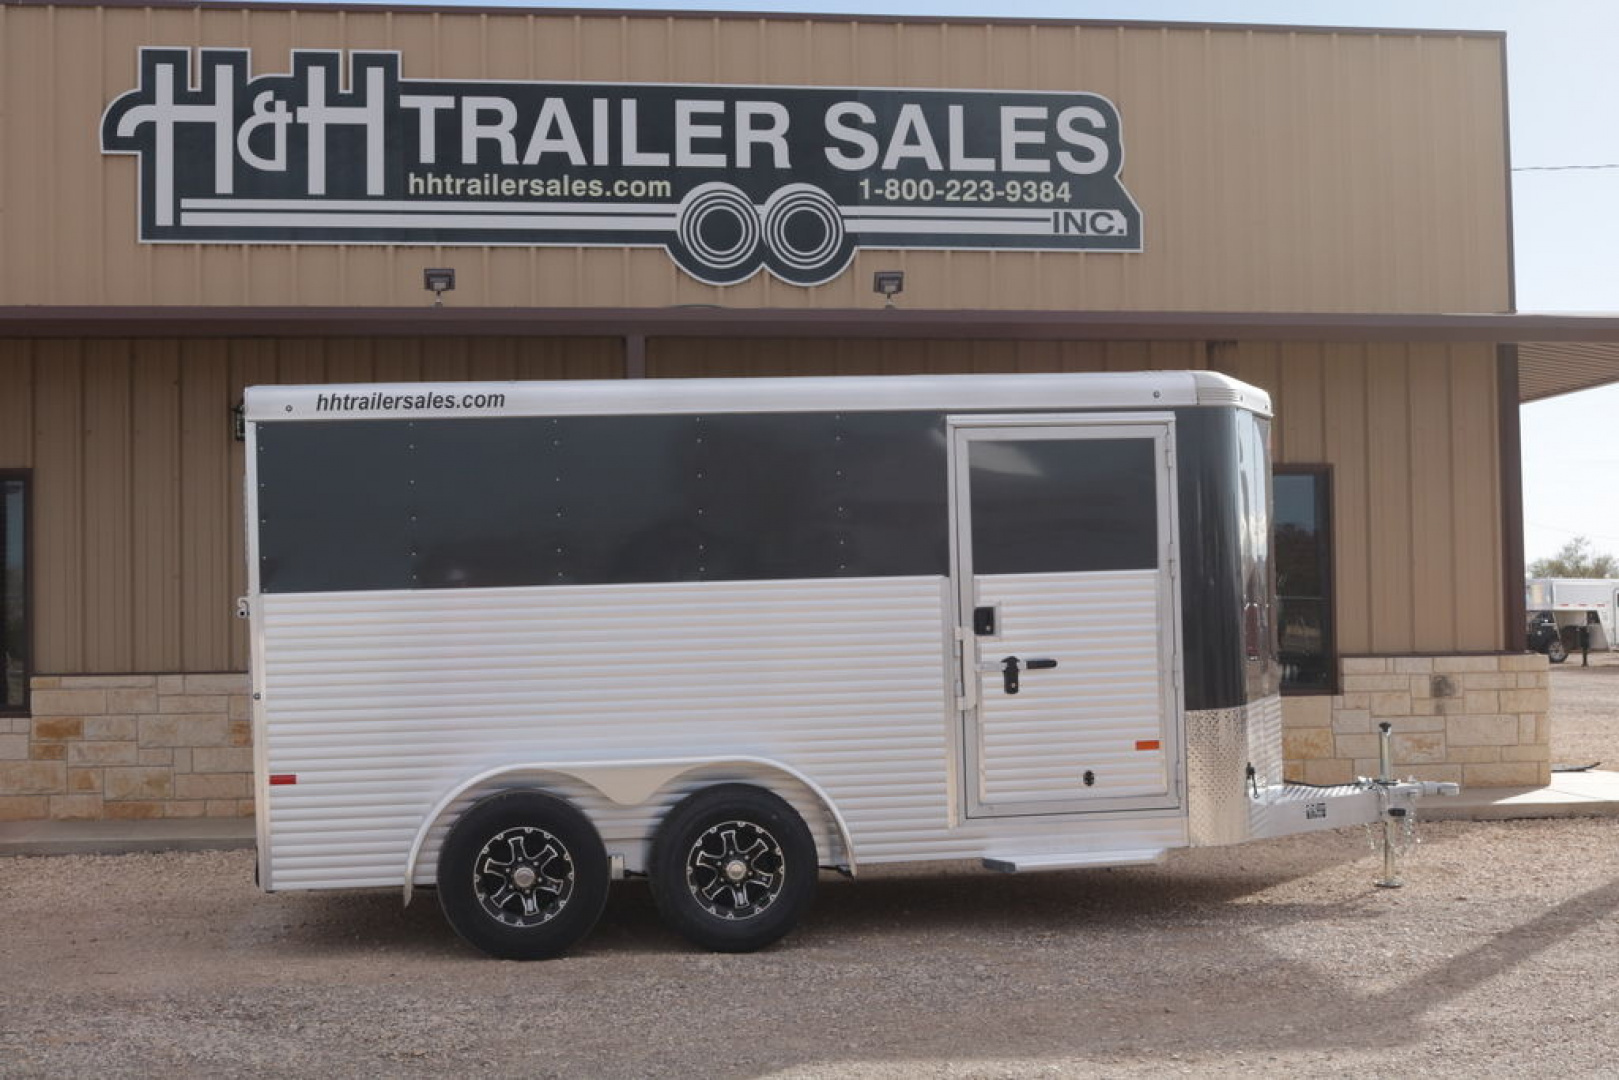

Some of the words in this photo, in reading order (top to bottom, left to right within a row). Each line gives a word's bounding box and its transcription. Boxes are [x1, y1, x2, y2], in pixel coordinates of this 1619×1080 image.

[116, 62, 385, 226] H&H
[399, 94, 792, 170] TRAILER
[824, 100, 1109, 174] SALES
[407, 172, 672, 199] hhtrailersales.com
[859, 178, 1072, 203] 1-800-223-9384
[1052, 209, 1125, 236] INC.
[315, 390, 505, 412] hhtrailersales.com
